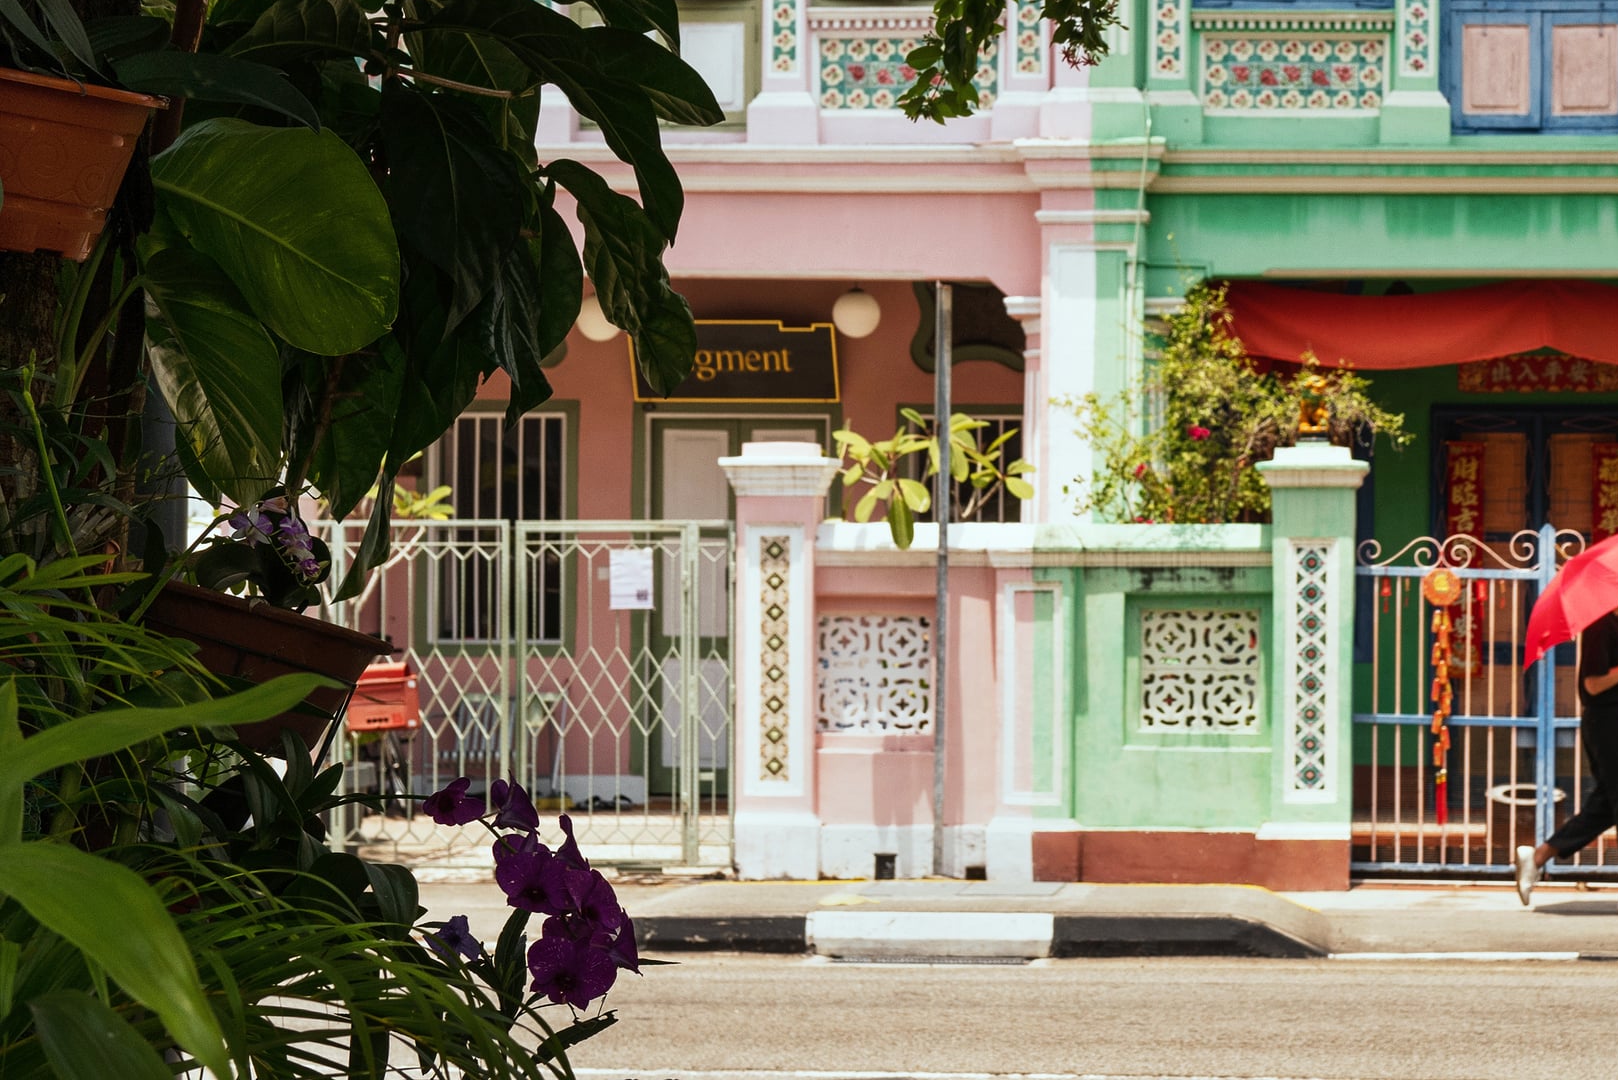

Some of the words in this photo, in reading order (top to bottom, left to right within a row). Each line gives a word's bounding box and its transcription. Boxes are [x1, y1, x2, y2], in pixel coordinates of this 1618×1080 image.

[693, 348, 793, 381] gment
[1491, 360, 1592, 383] 出入平安
